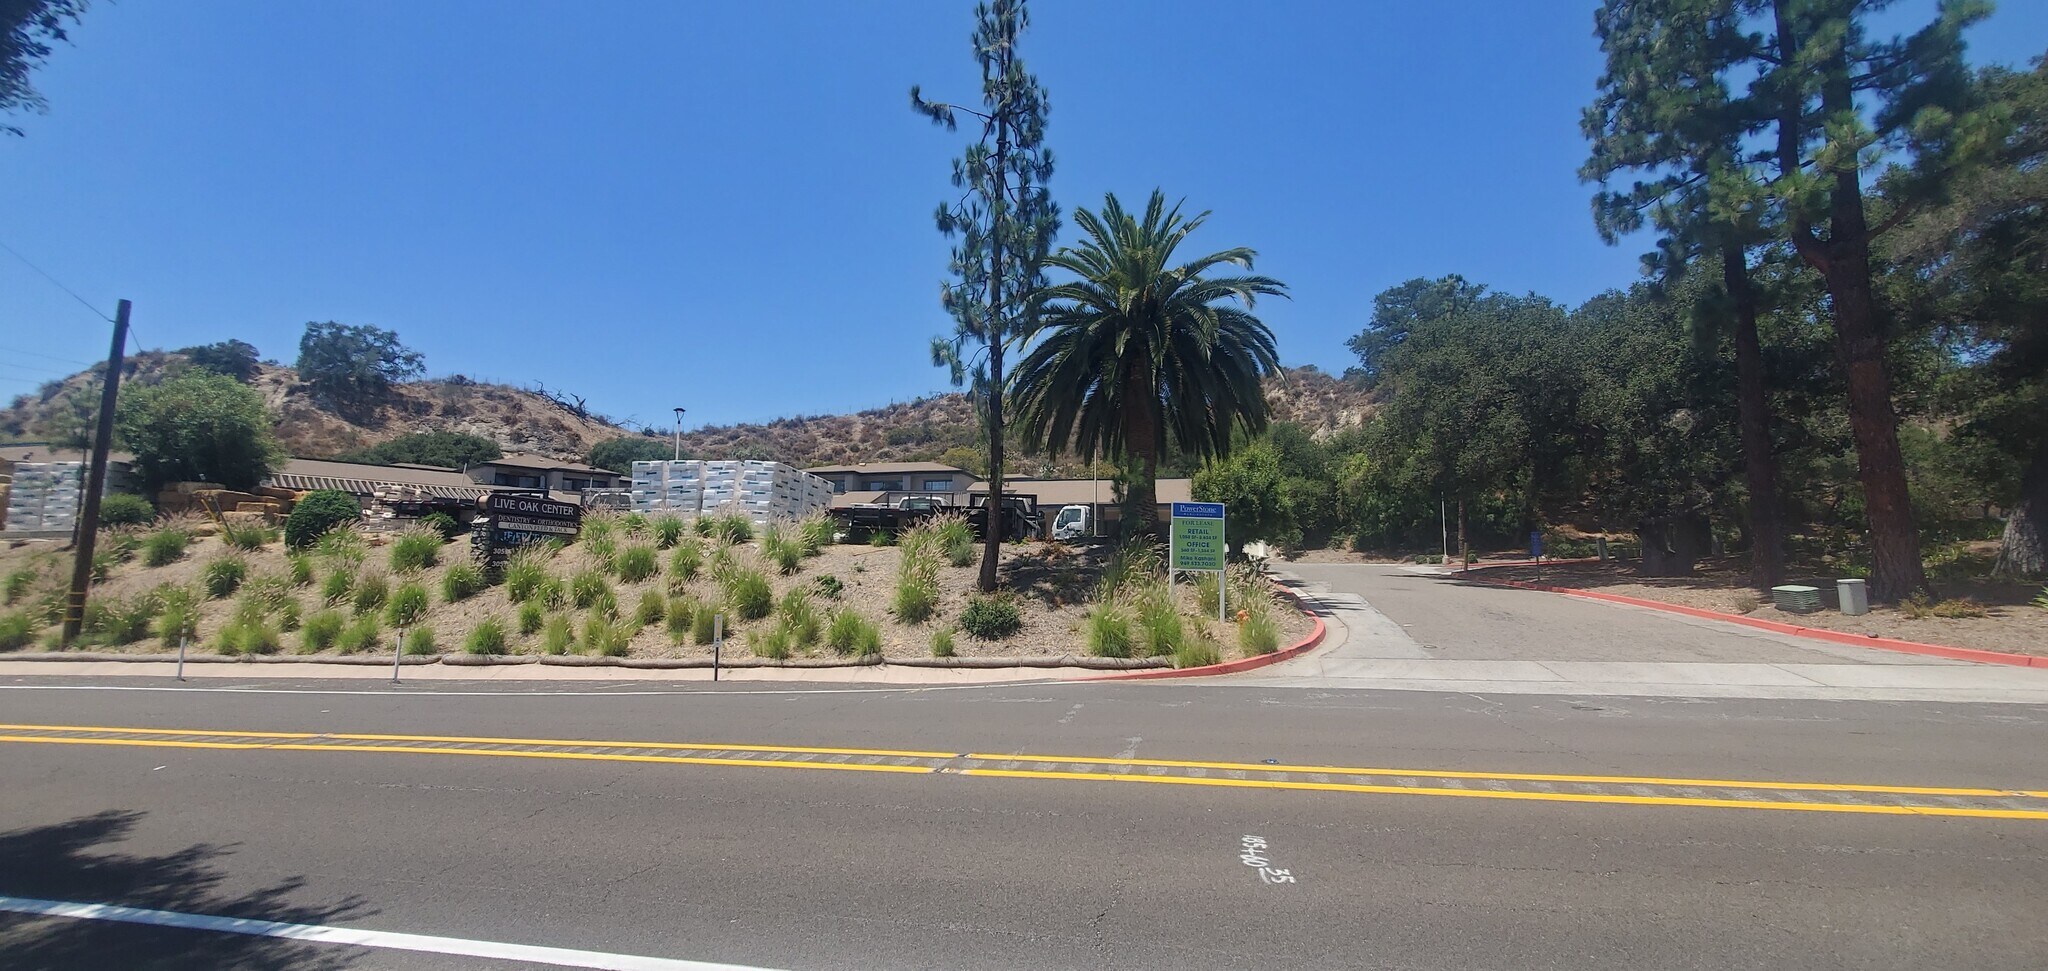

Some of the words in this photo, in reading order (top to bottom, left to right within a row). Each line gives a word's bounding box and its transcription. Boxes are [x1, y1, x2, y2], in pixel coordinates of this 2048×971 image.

[494, 498, 516, 510] LIVE
[519, 501, 539, 512] OAK
[541, 504, 574, 516] CENTER
[498, 515, 531, 523] DENTISTRY
[537, 519, 578, 528] ORTHODONTICS
